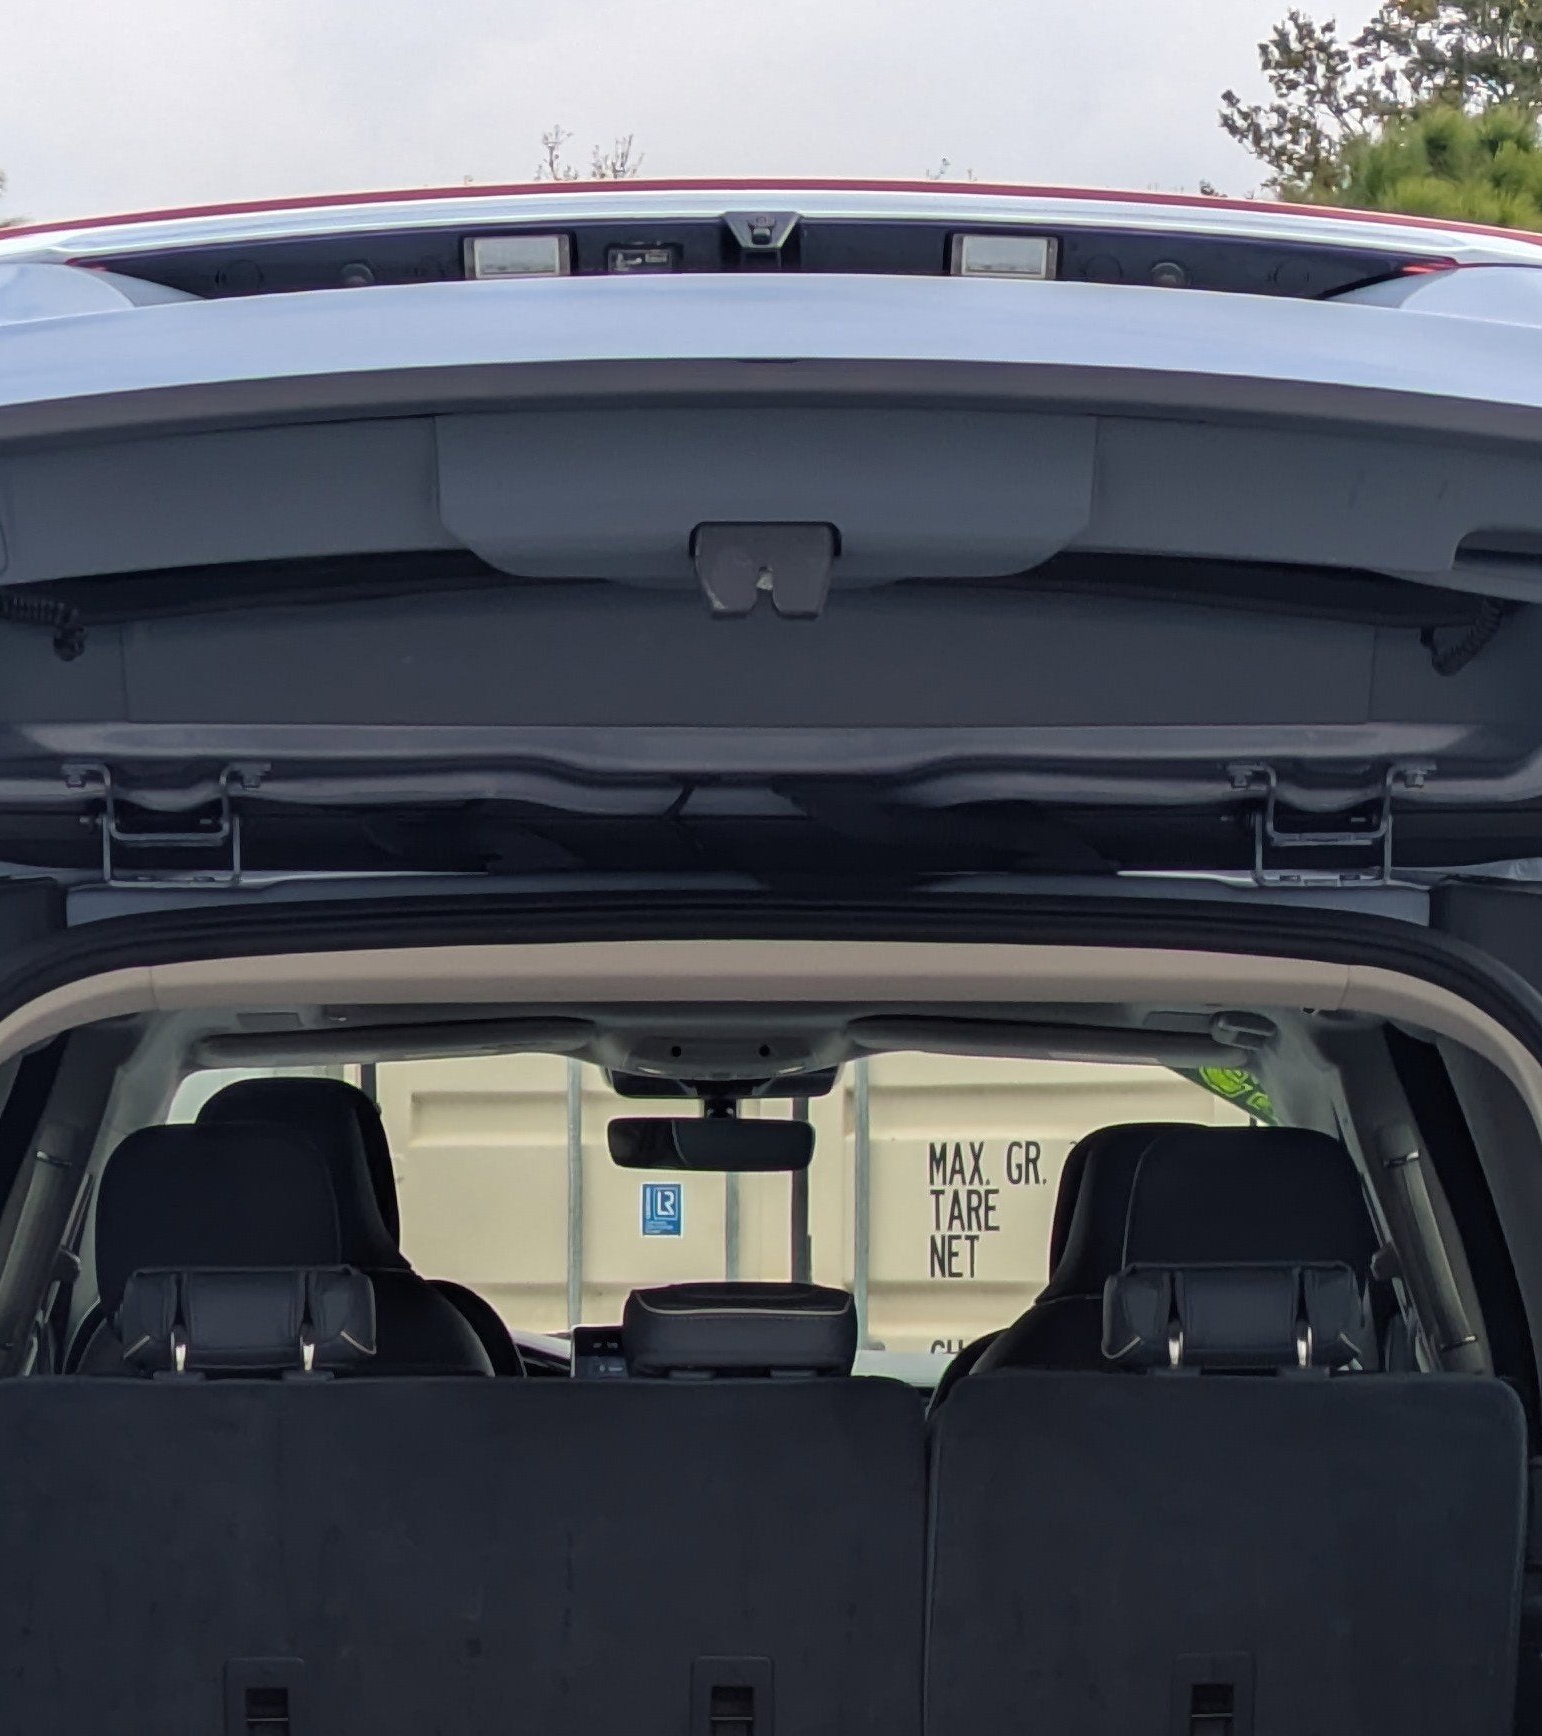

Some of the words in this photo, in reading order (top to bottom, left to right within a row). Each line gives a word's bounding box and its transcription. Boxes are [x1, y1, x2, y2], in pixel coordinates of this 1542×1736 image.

[928, 1141, 990, 1186] MAX.
[1006, 1140, 1048, 1185] GR.
[930, 1188, 1000, 1231] TARE
[930, 1234, 979, 1278] NET
